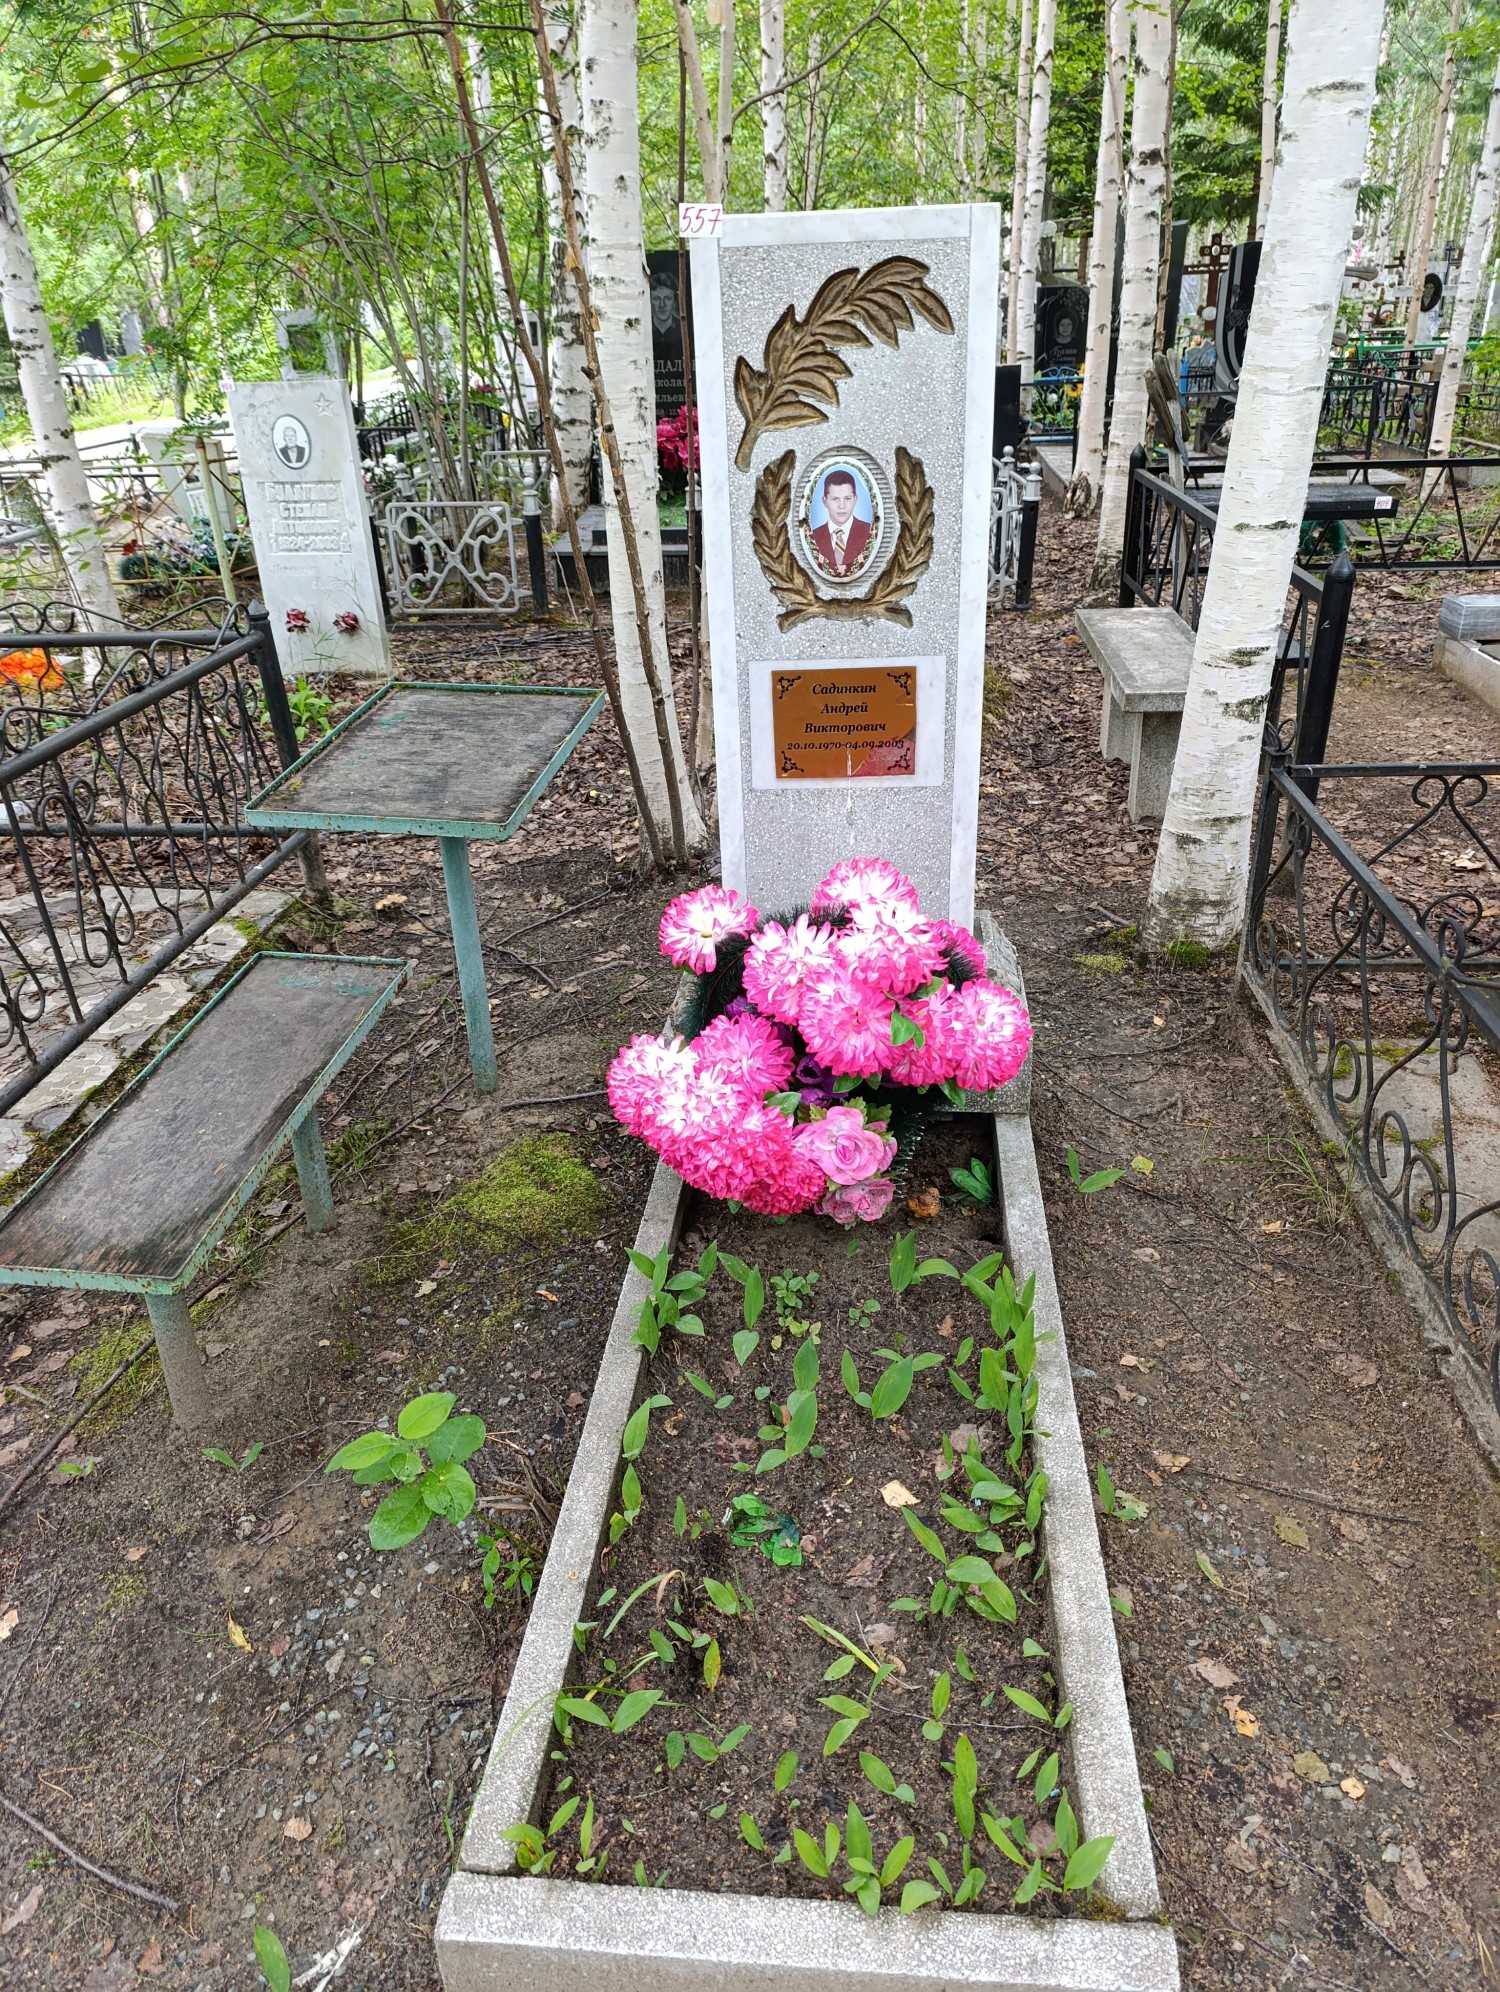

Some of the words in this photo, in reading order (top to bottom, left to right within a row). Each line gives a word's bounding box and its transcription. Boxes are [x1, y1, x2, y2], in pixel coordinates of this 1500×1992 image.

[680, 206, 723, 235] 557
[812, 682, 877, 695] Садинкин
[820, 702, 869, 716] Андрей
[804, 722, 886, 735] Викторович
[787, 739, 904, 751] 20.10.1970-04.09.2003
